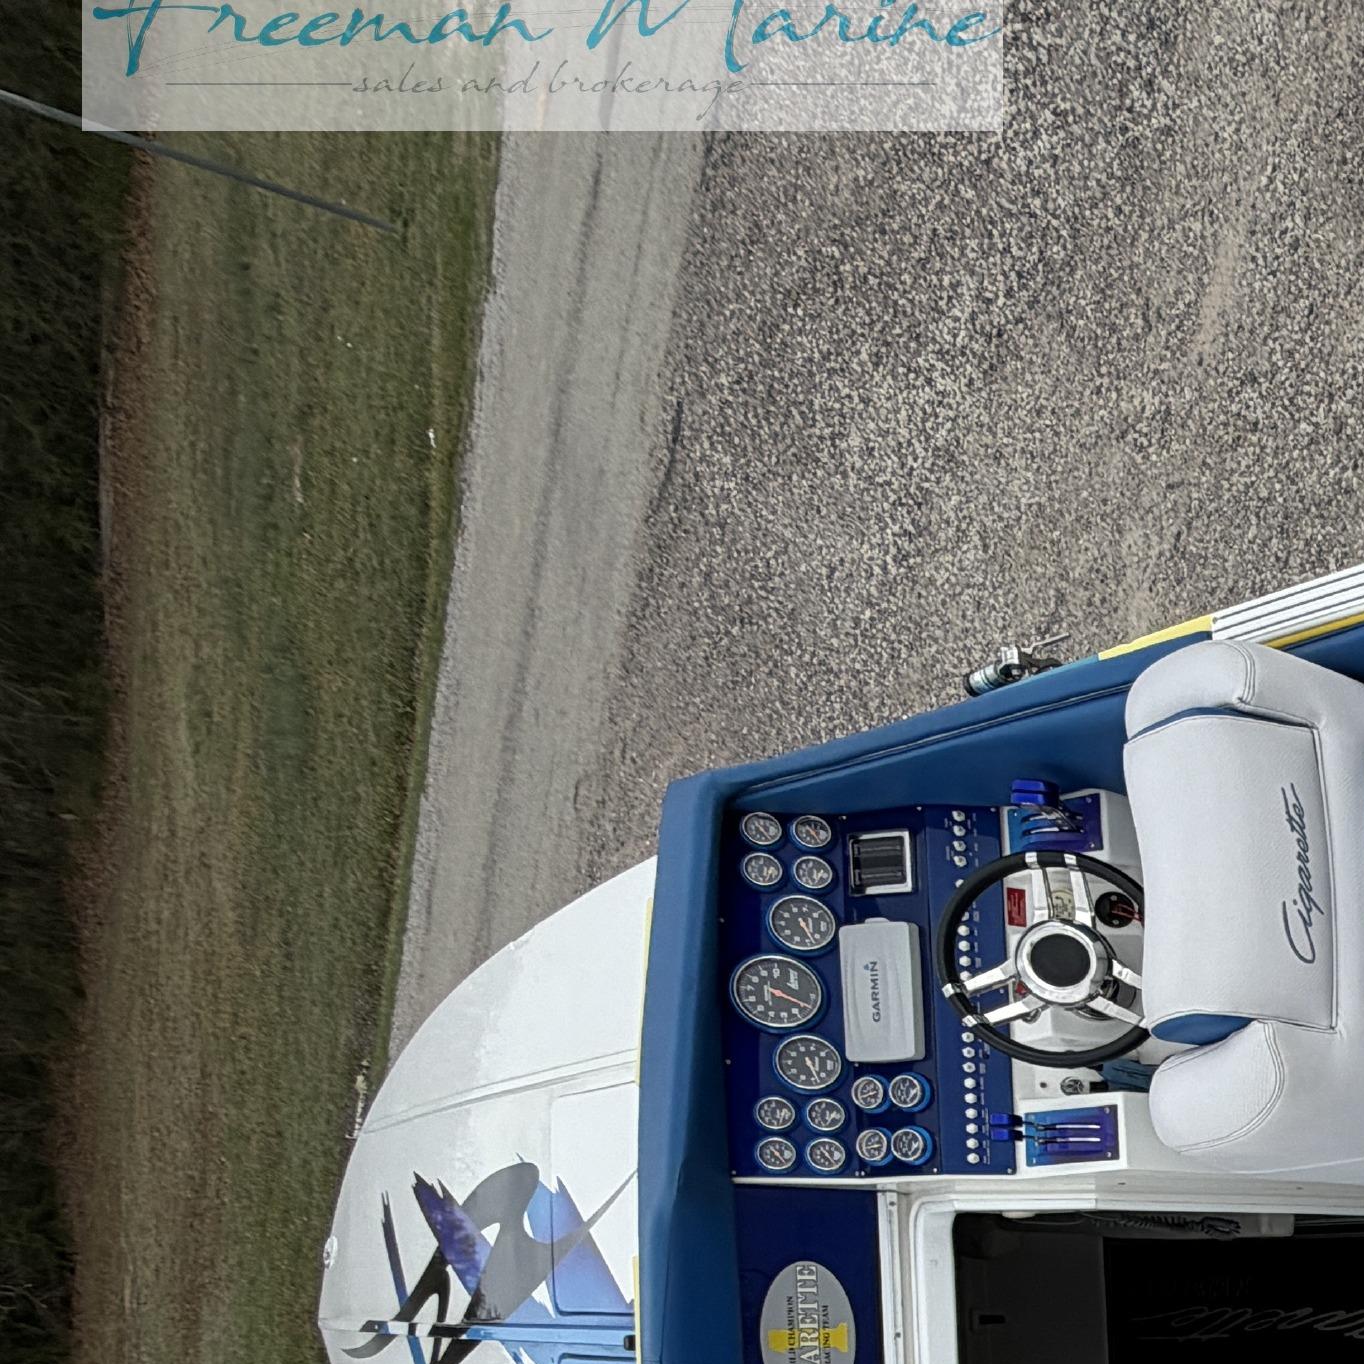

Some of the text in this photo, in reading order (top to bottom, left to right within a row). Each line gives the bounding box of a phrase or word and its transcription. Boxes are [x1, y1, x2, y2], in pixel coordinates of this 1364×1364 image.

[1280, 782, 1325, 964] Cigarette
[868, 961, 882, 1023] GARMIN
[786, 1295, 796, 1346] CHAMPION
[820, 1304, 830, 1329] TEAM
